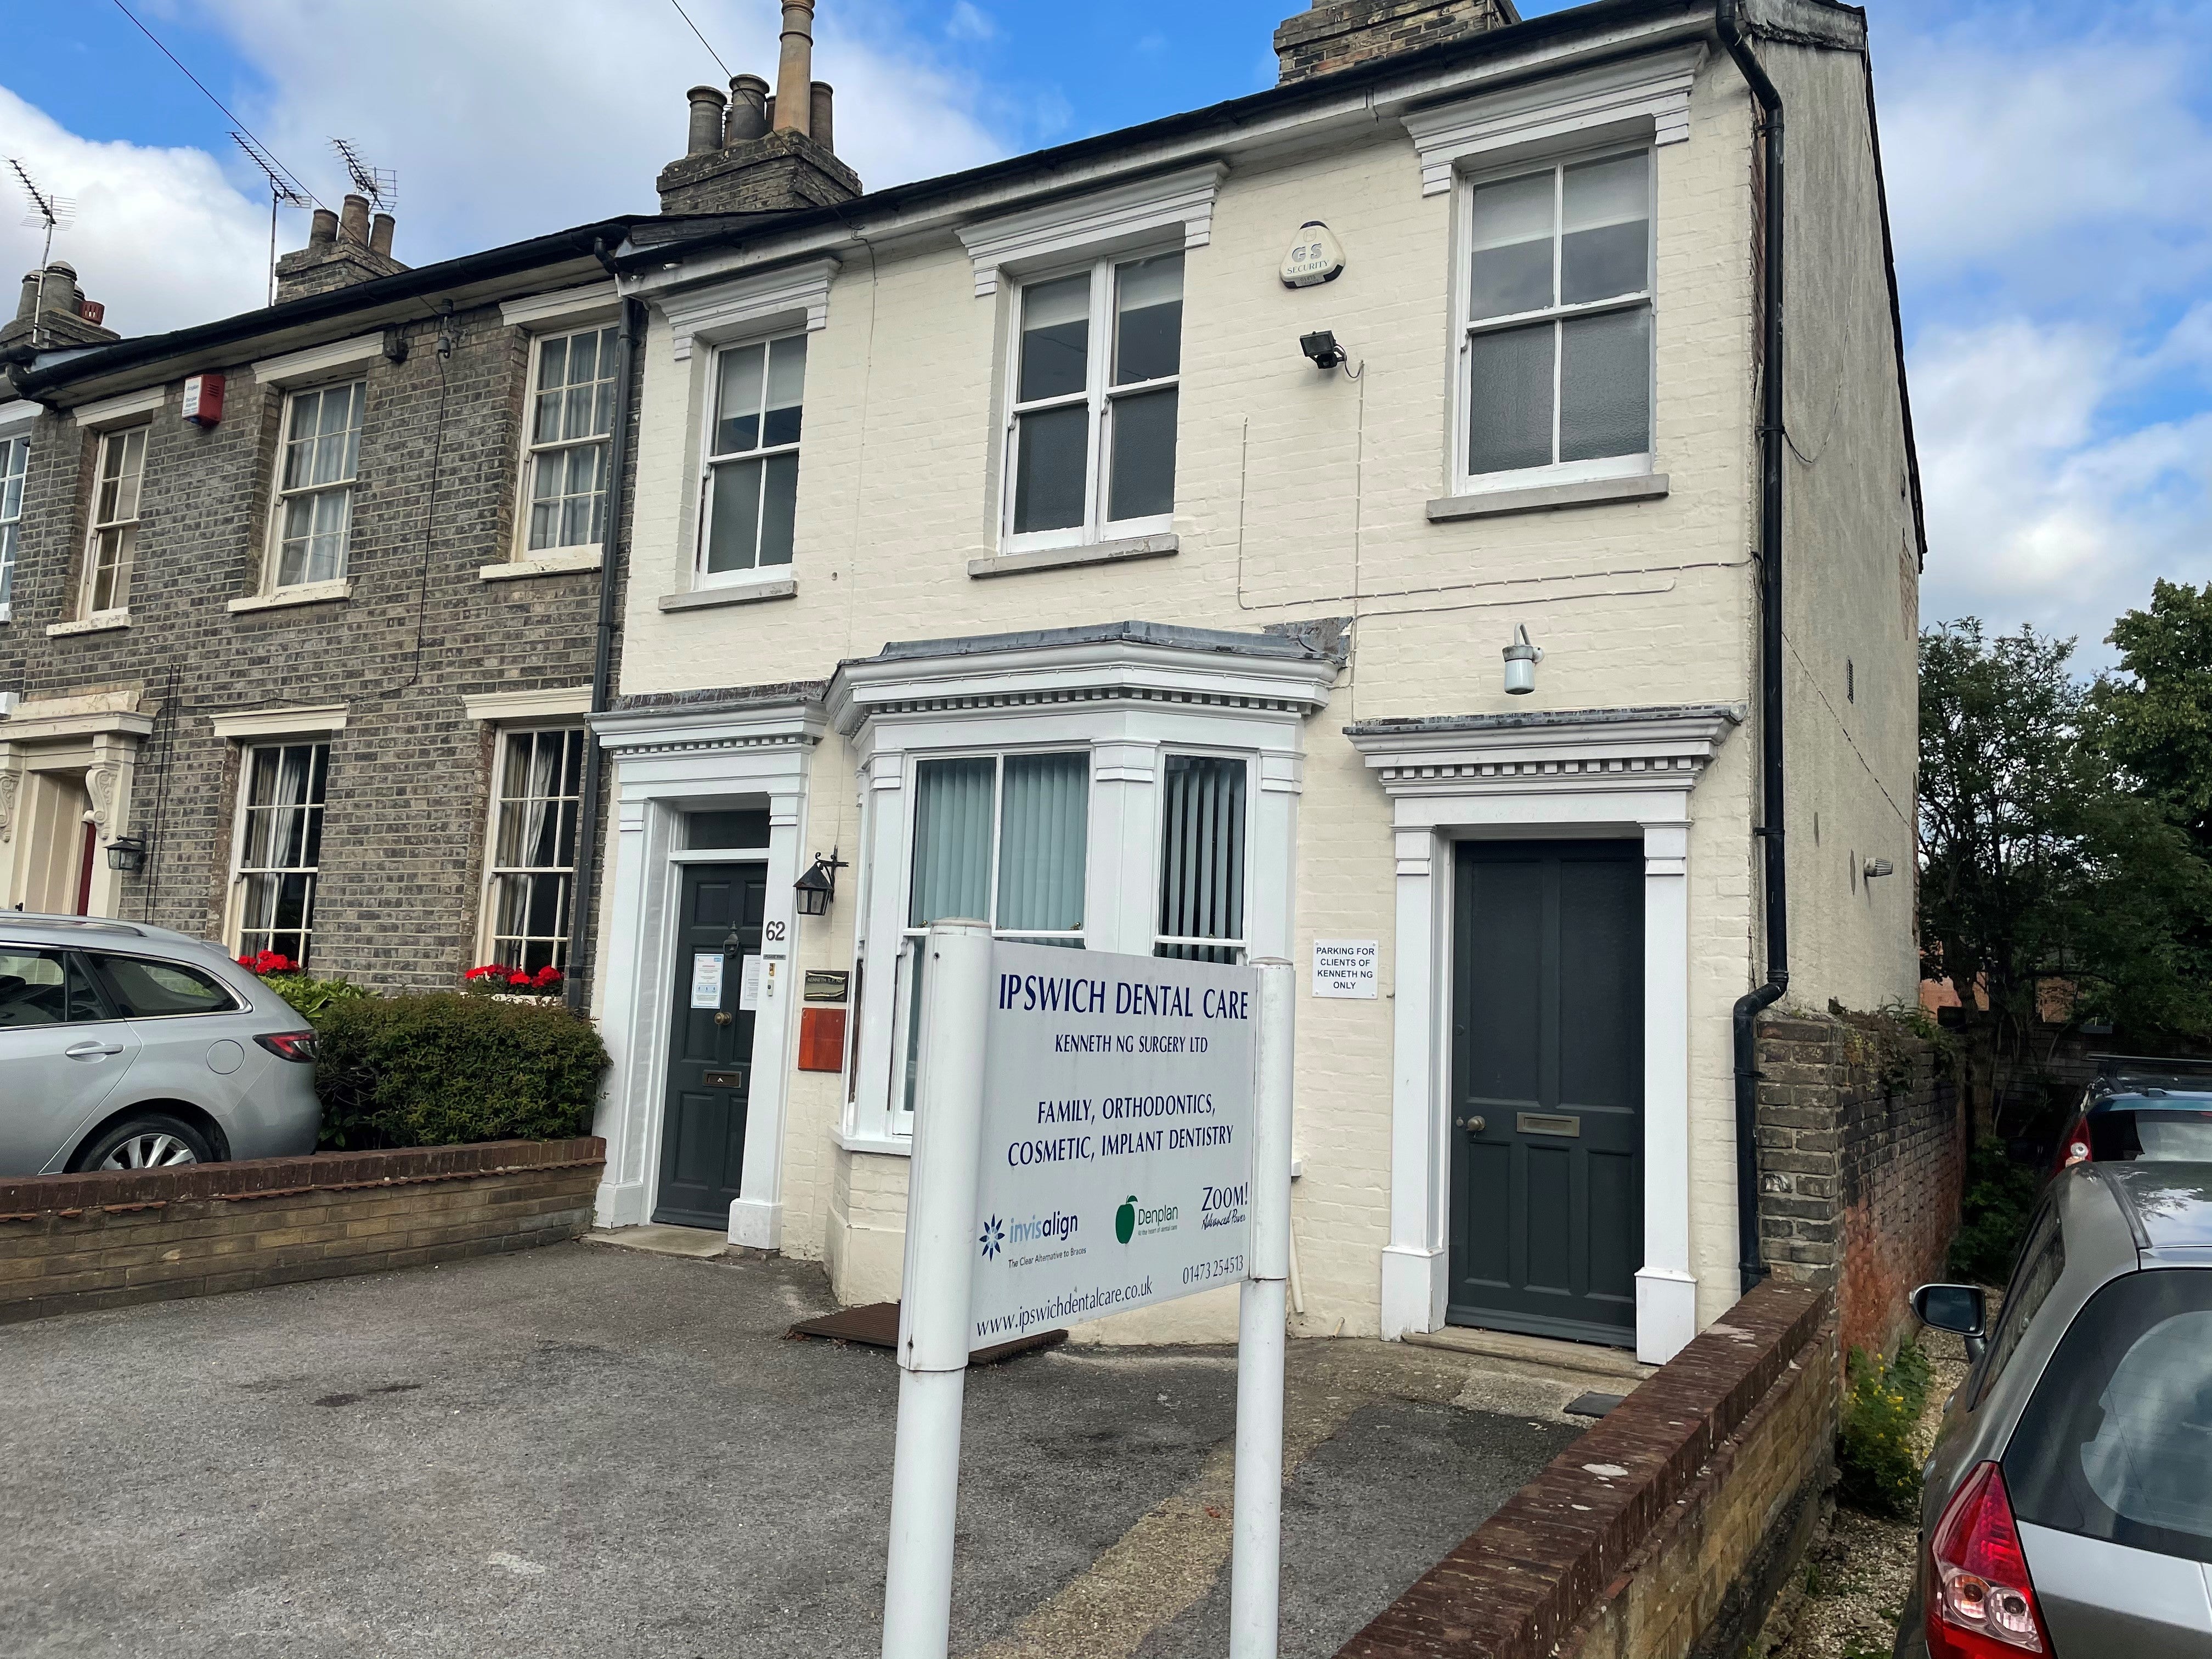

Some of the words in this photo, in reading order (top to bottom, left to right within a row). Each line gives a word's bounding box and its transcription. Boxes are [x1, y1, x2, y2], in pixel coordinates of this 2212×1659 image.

[1286, 259, 1329, 274] SECURITY
[766, 921, 785, 941] 62
[1320, 958, 1356, 967] CLIENTS
[999, 974, 1106, 1014] IPSWICH
[1115, 982, 1193, 1017] DENTAL
[1203, 988, 1248, 1019] CARE
[1055, 1034, 1111, 1053] KENNETH
[1116, 1035, 1133, 1053] NG
[1139, 1036, 1186, 1053] SURGERY
[1190, 1037, 1208, 1053] LTD
[1037, 1099, 1095, 1125] FAMILY,
[1102, 1093, 1216, 1118] ORTHODONTICS,
[1008, 1136, 1095, 1166] COSMETIC,
[1102, 1131, 1164, 1156] IMPLANT
[1169, 1125, 1234, 1150] DENTISTRY
[1201, 1182, 1248, 1212] ZOOM!
[1009, 1211, 1078, 1244] invisalign
[1138, 1204, 1178, 1227] Denplan
[1201, 1210, 1232, 1231] Advanced
[1231, 1208, 1246, 1225] Power
[1008, 1259, 1018, 1268] The
[1020, 1256, 1034, 1266] Clear
[1035, 1251, 1063, 1263] Alternative
[1070, 1247, 1087, 1257] Braces
[1183, 1262, 1211, 1285] 01473
[1212, 1254, 1244, 1278] 254513
[977, 1275, 1153, 1337] www.ipswichdentalcare.co.uk
